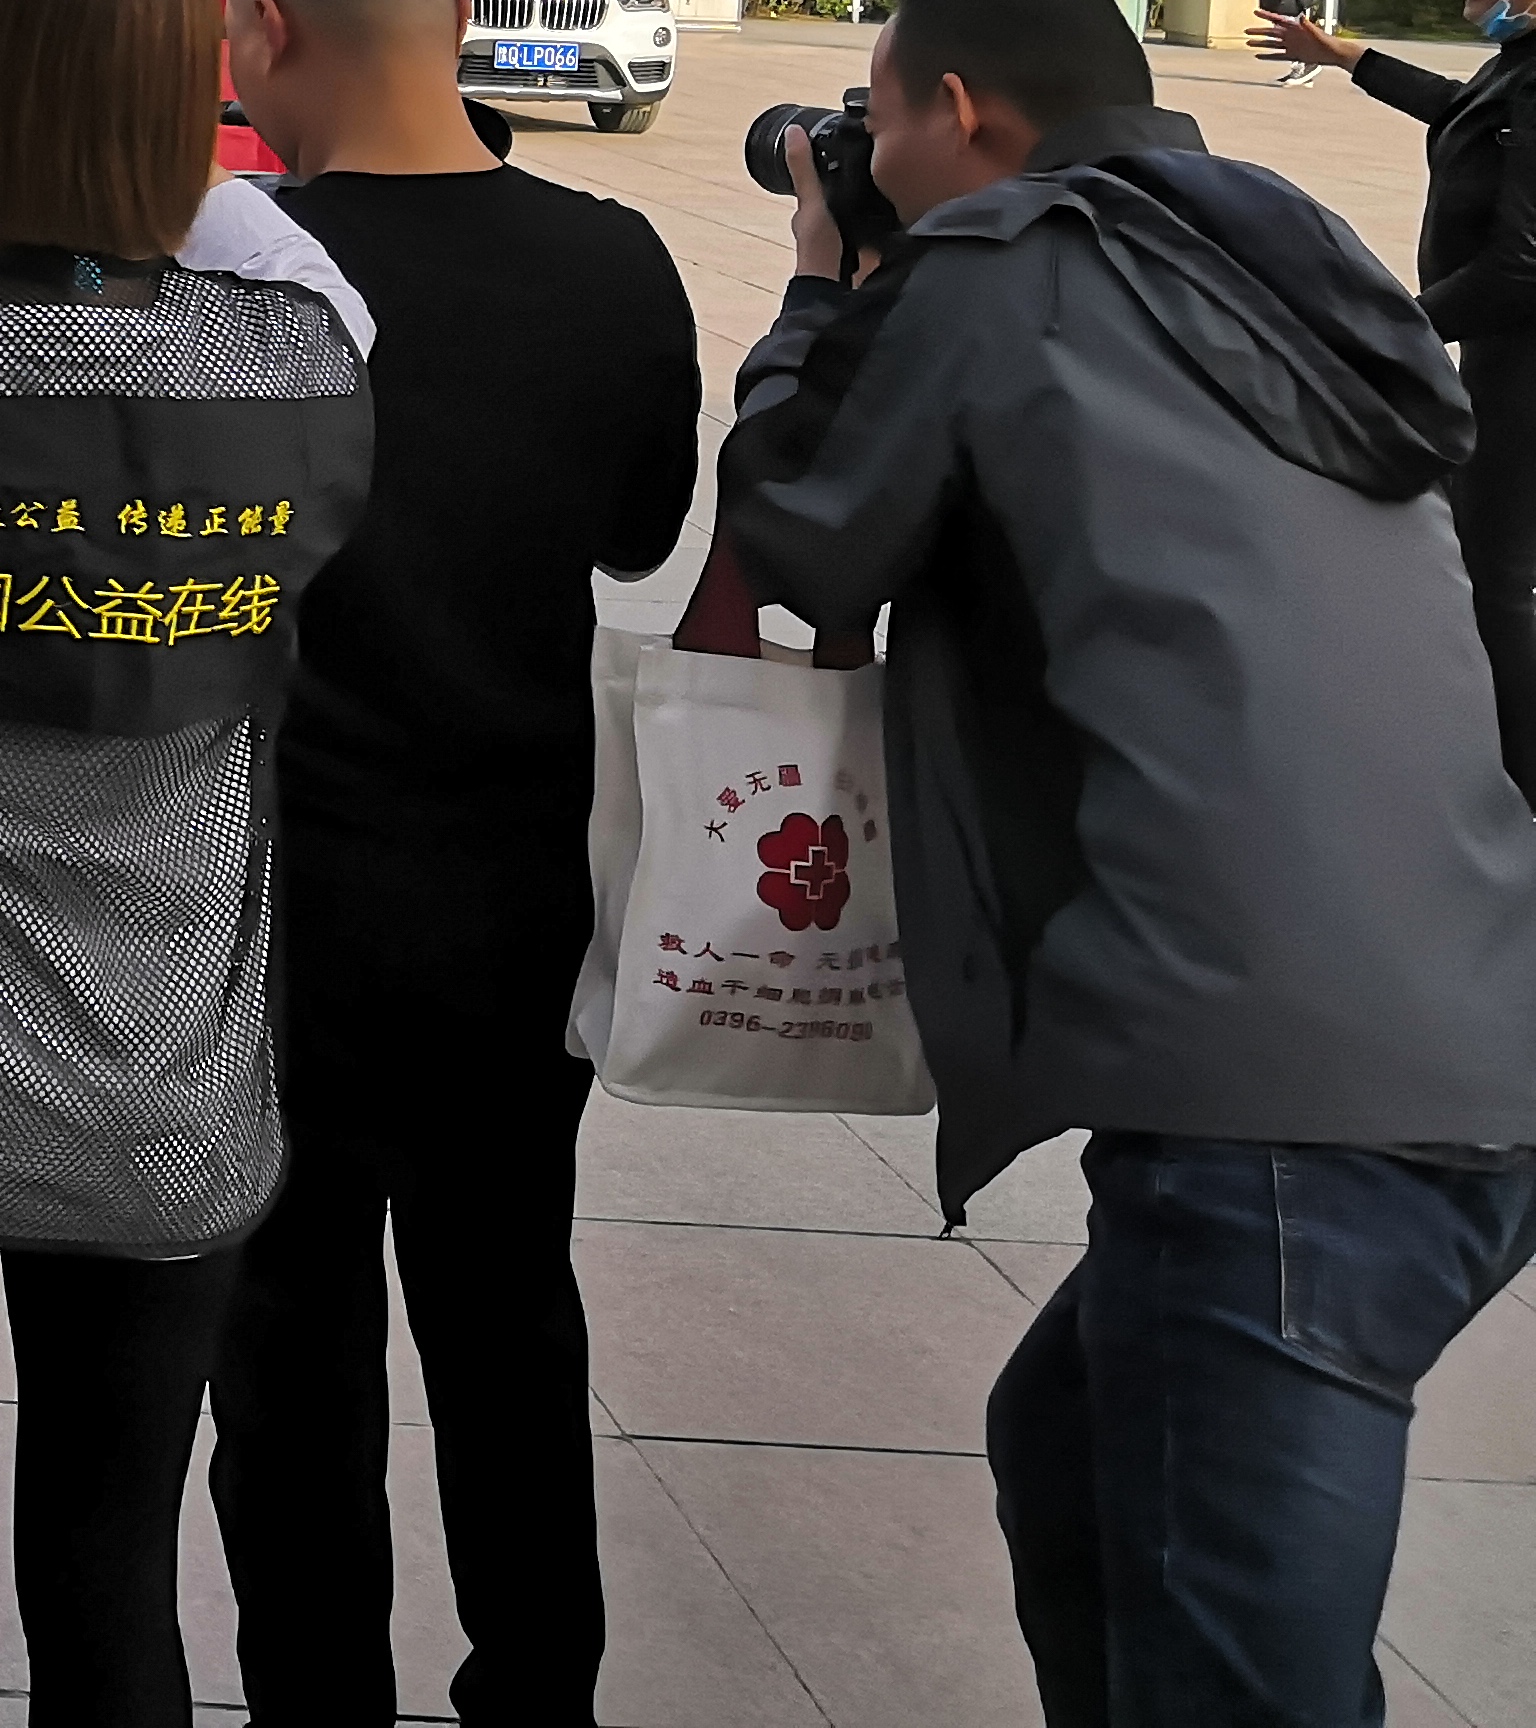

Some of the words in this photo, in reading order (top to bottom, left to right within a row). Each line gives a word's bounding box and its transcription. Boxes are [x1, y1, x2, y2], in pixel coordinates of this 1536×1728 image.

[117, 500, 295, 538] 传递正能量
